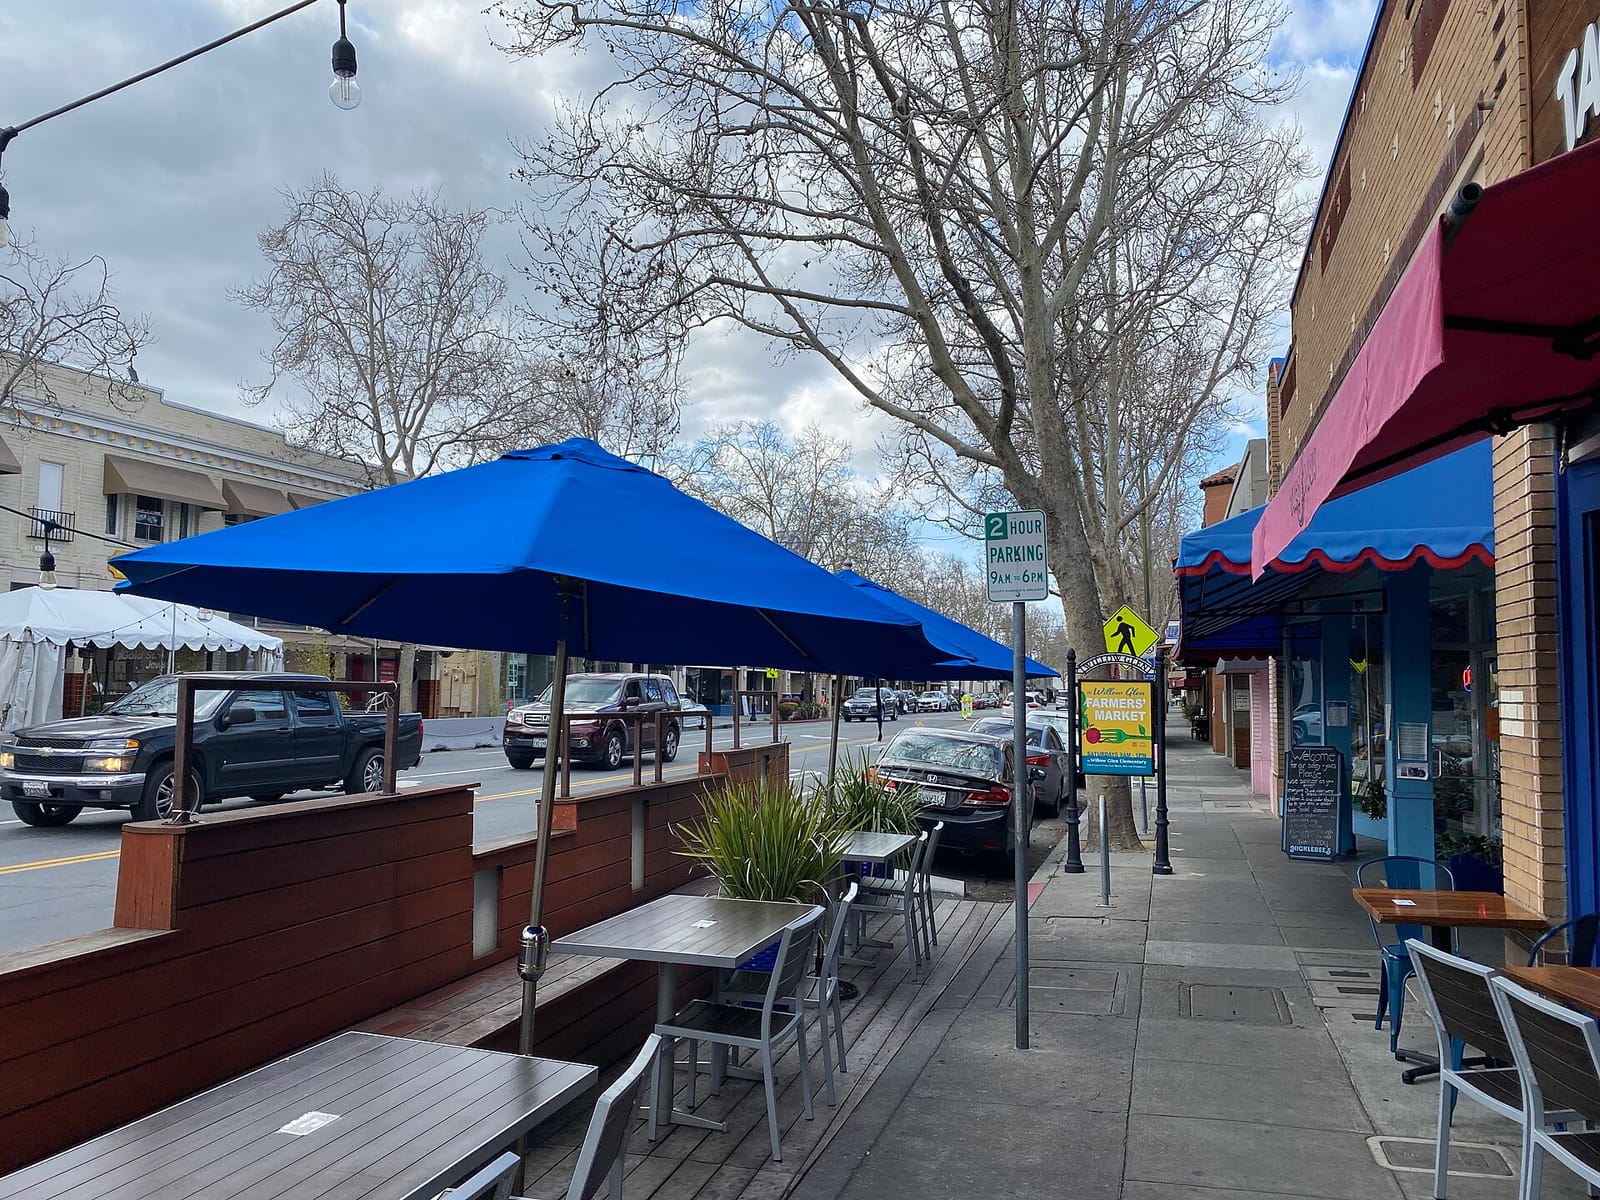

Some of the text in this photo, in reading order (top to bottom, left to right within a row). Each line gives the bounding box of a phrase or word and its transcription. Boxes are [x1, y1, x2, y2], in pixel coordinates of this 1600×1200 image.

[1557, 22, 1600, 152] TA
[990, 517, 1042, 537] 2 HOUR
[990, 544, 1043, 563] PARKING
[1093, 687, 1122, 696] Willow
[1125, 687, 1145, 697] Glen
[1086, 697, 1146, 709] FARMERS'
[1094, 710, 1146, 721] MARKET
[1290, 749, 1336, 762] Welcome
[1298, 768, 1322, 779] Please
